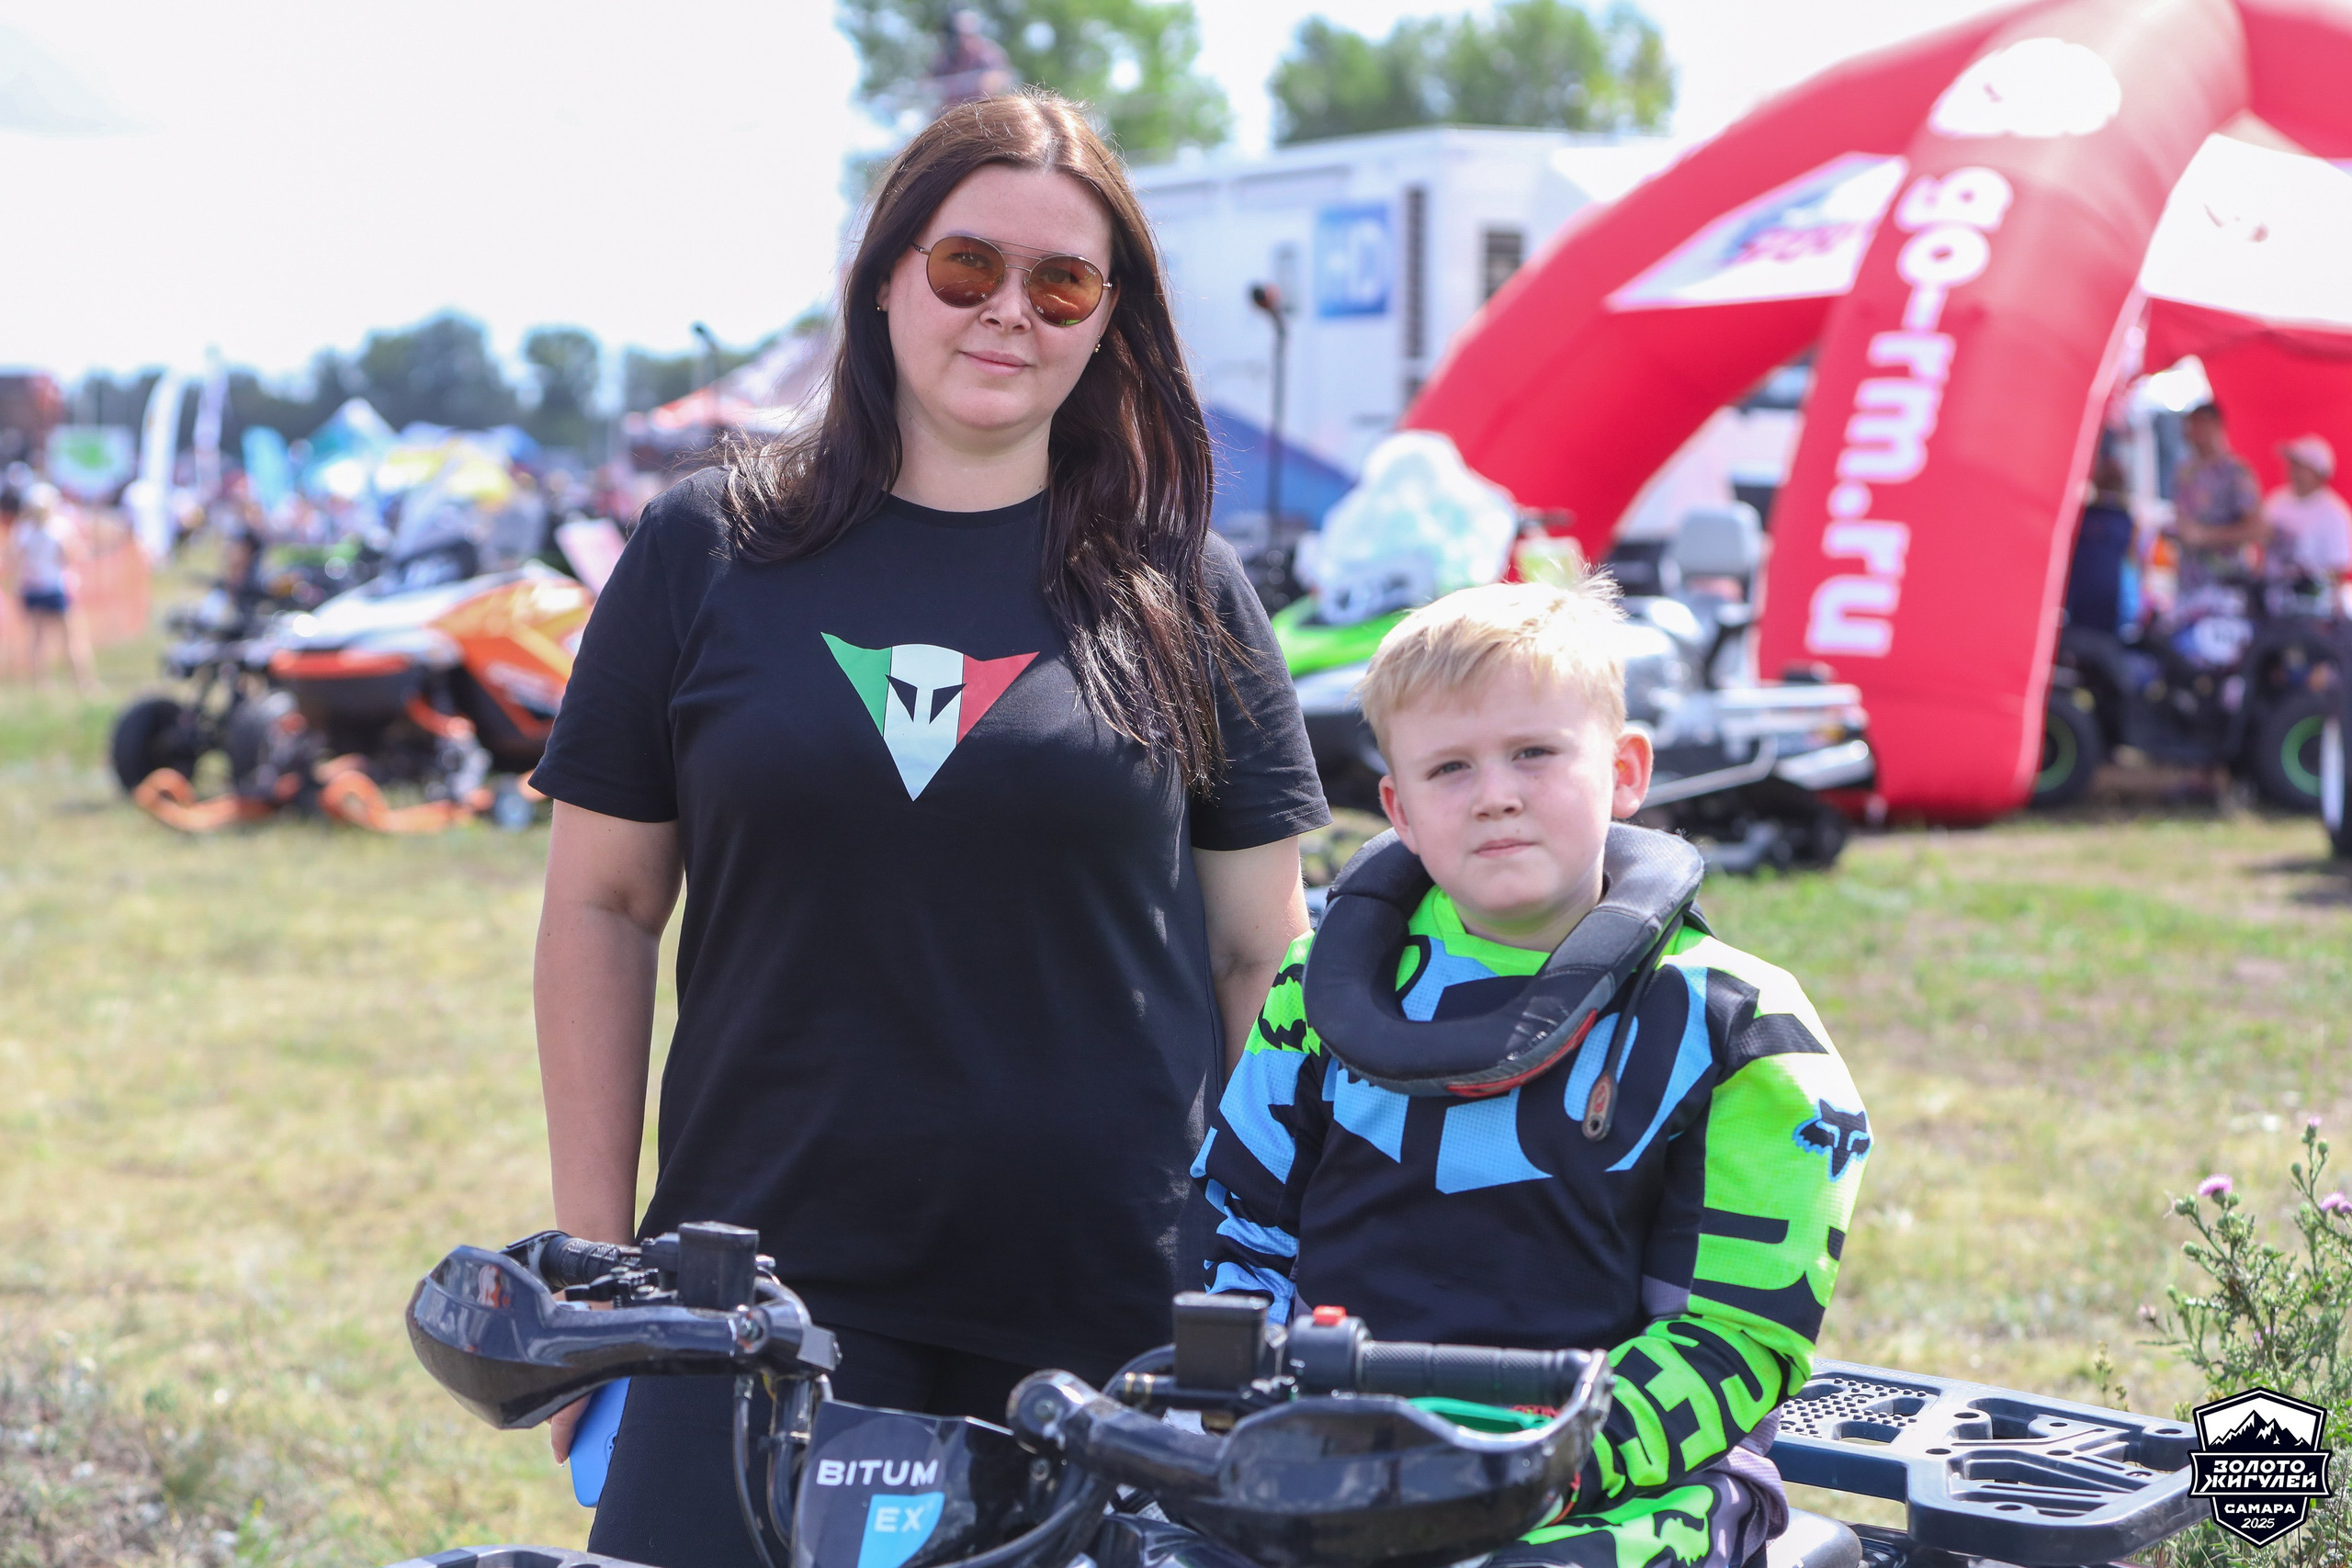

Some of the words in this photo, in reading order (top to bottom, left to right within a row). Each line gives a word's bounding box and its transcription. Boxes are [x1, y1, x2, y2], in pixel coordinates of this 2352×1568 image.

[1806, 167, 2012, 656] go-rm.ru
[816, 1459, 939, 1486] BITUM
[875, 1506, 925, 1533] EX
